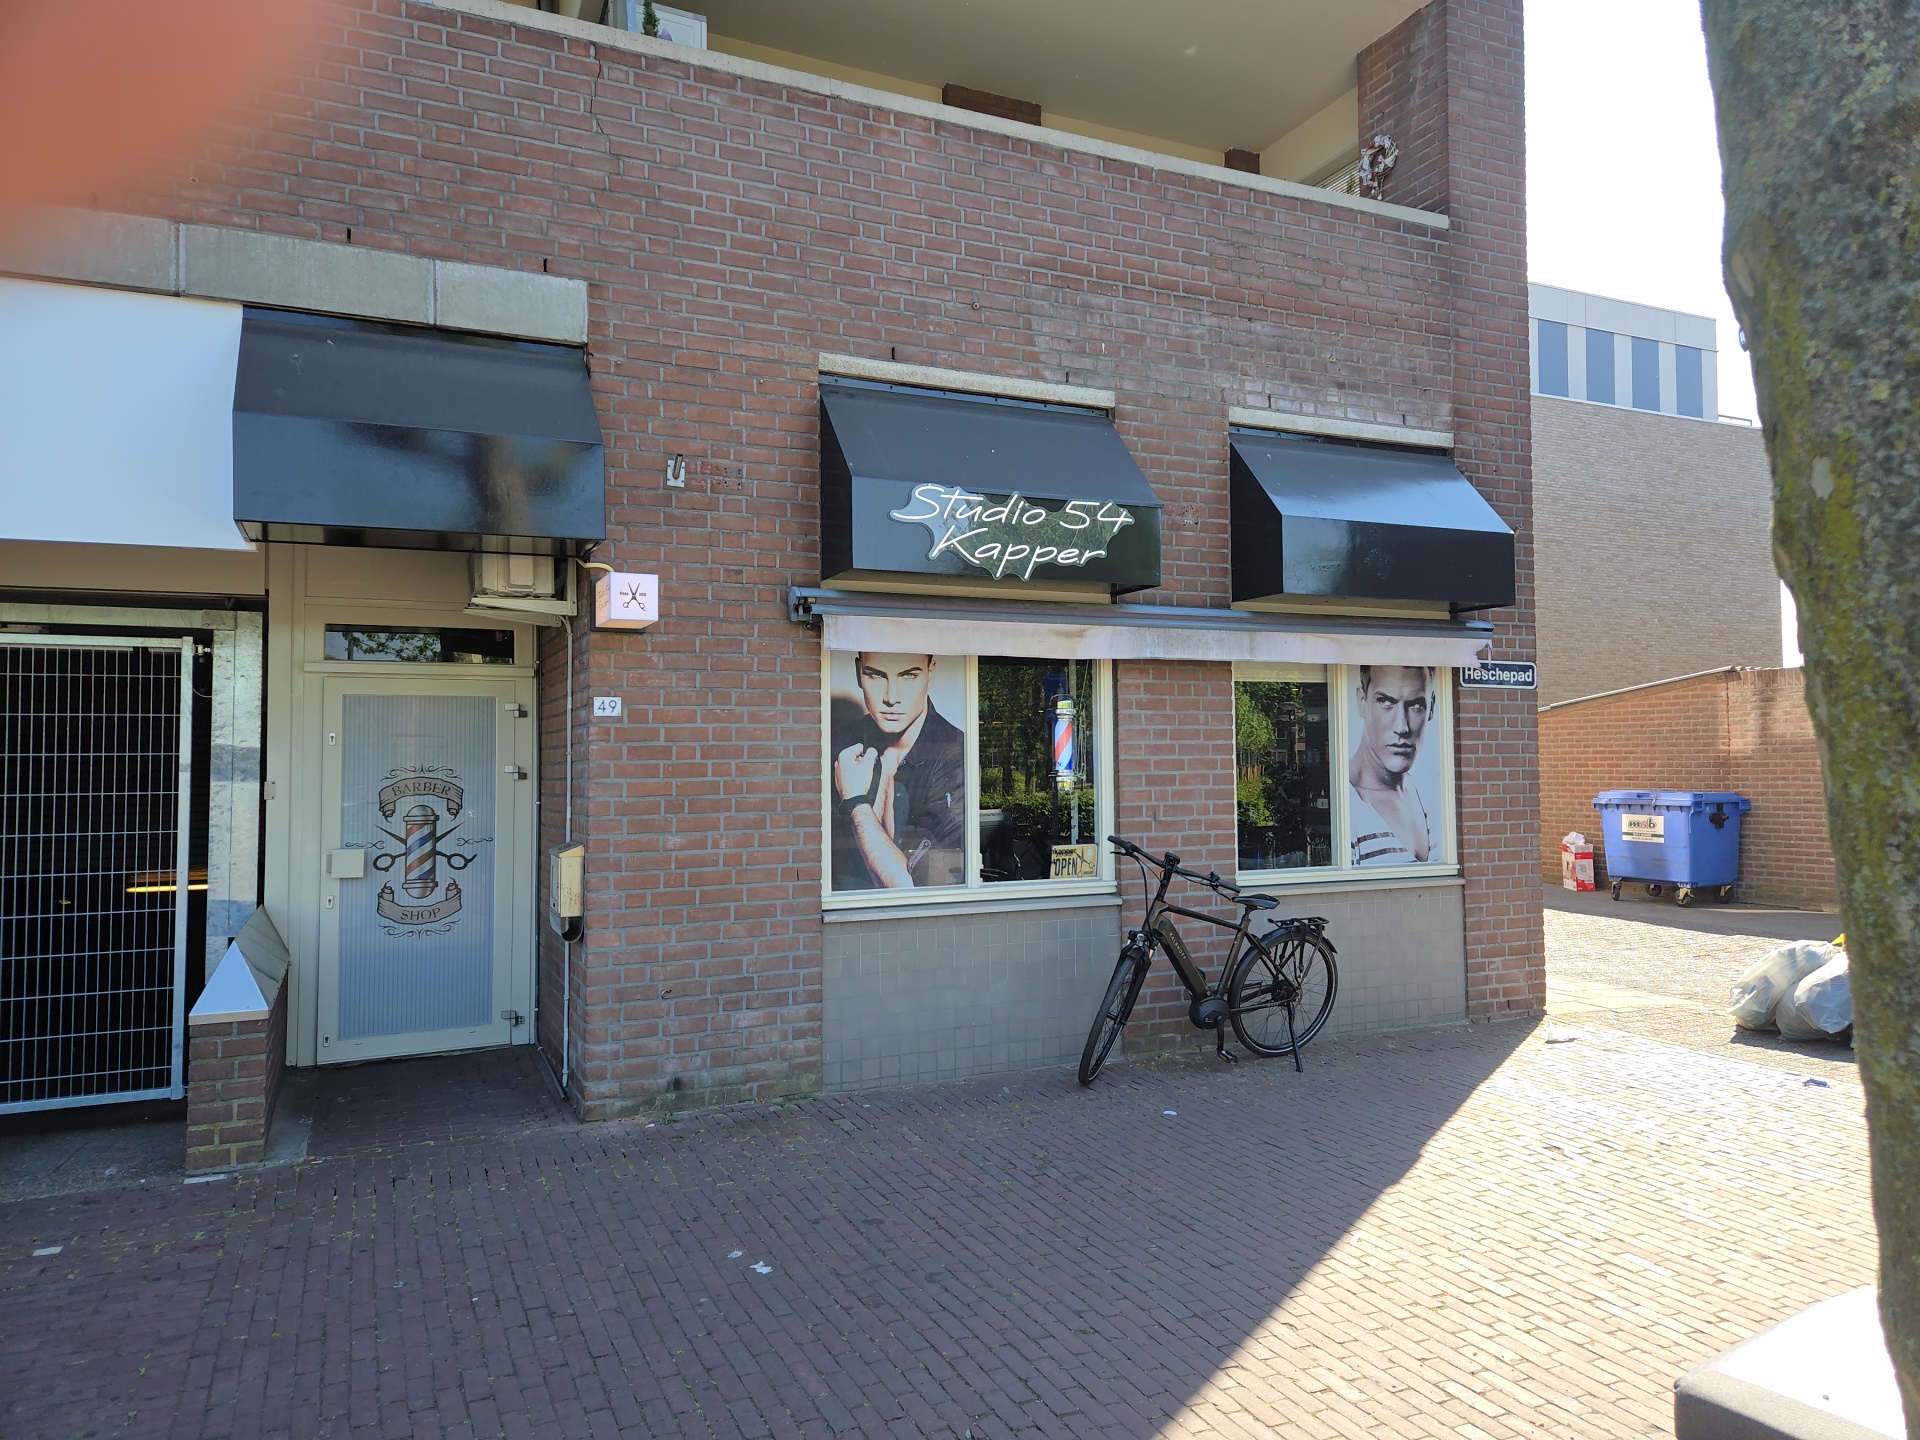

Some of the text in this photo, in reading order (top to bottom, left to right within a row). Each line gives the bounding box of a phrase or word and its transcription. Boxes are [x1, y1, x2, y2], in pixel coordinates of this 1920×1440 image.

[893, 485, 1135, 533] Studio 54
[931, 525, 1106, 579] Kapper
[1464, 667, 1533, 684] Heschepad
[597, 699, 618, 714] 49
[392, 782, 451, 797] BARBER
[1054, 857, 1078, 877] OPEN
[400, 907, 441, 922] SHOP
